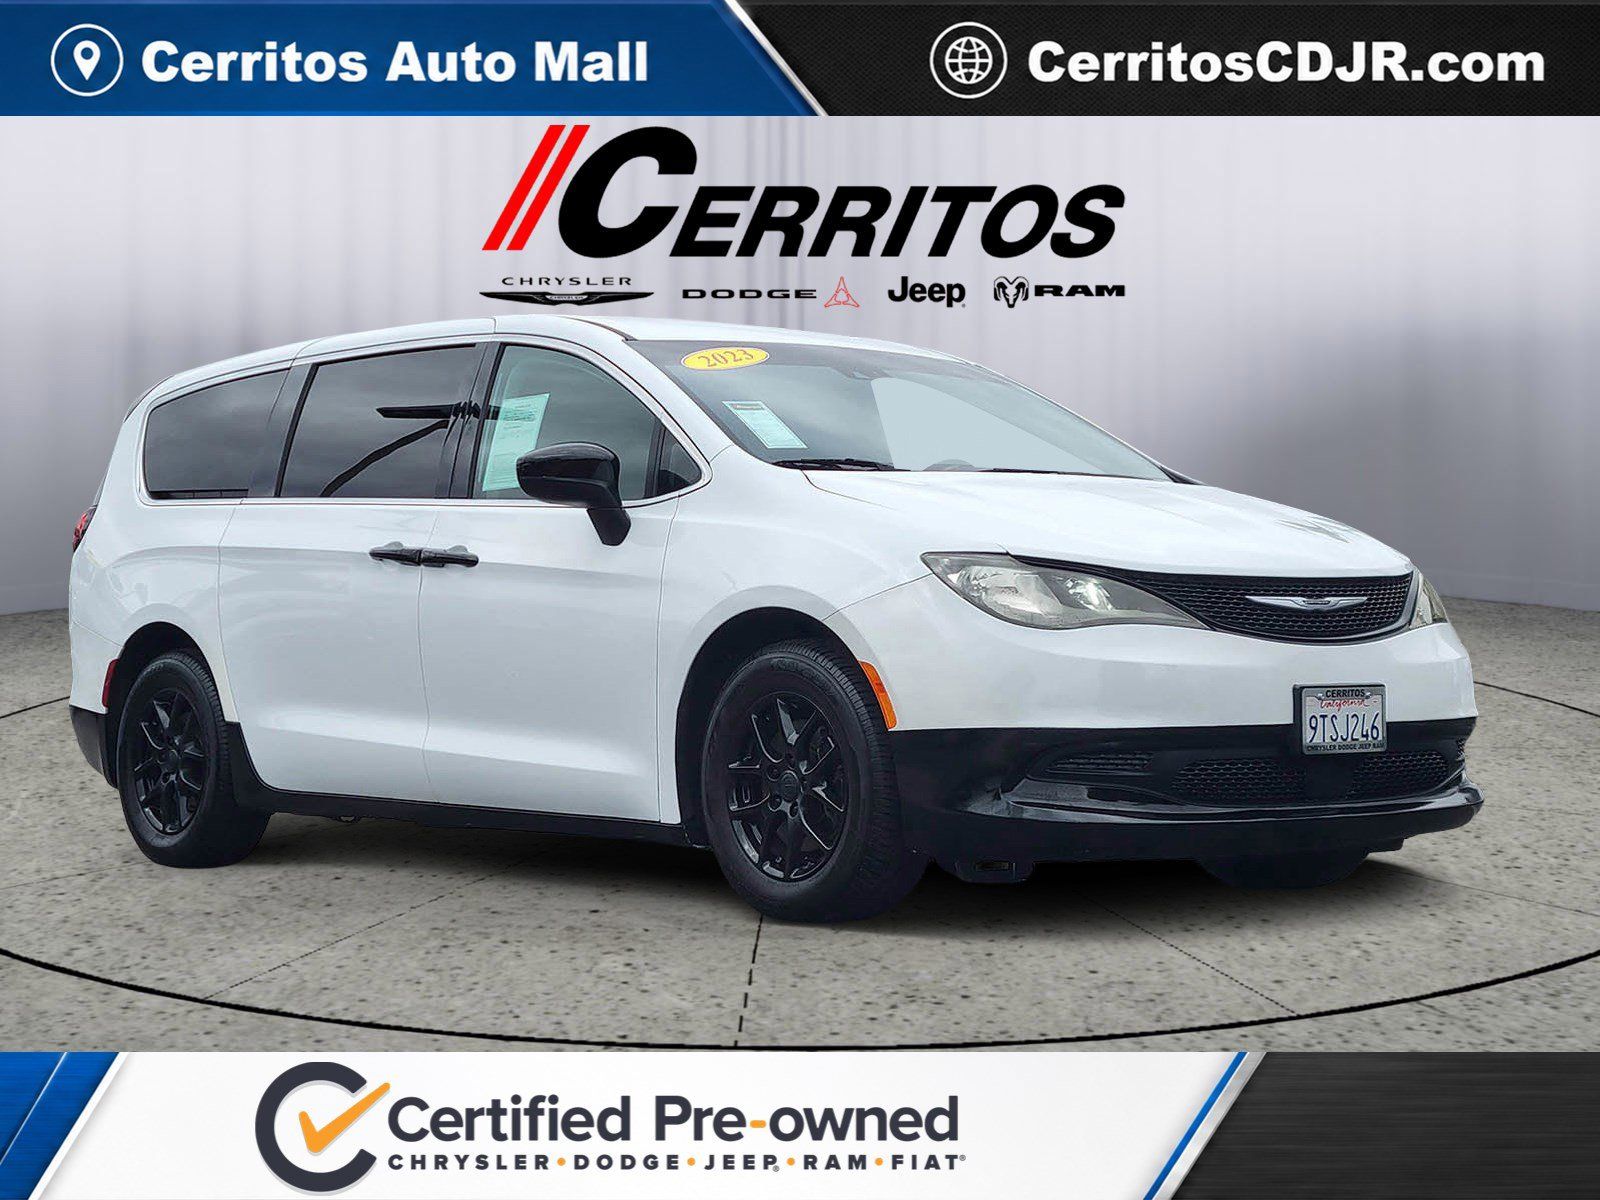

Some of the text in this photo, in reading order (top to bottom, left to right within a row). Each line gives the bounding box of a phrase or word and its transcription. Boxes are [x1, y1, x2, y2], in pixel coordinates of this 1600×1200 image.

[698, 349, 754, 367] 2023
[1325, 689, 1366, 698] CERRITOS
[1308, 712, 1380, 743] 9TSJ246
